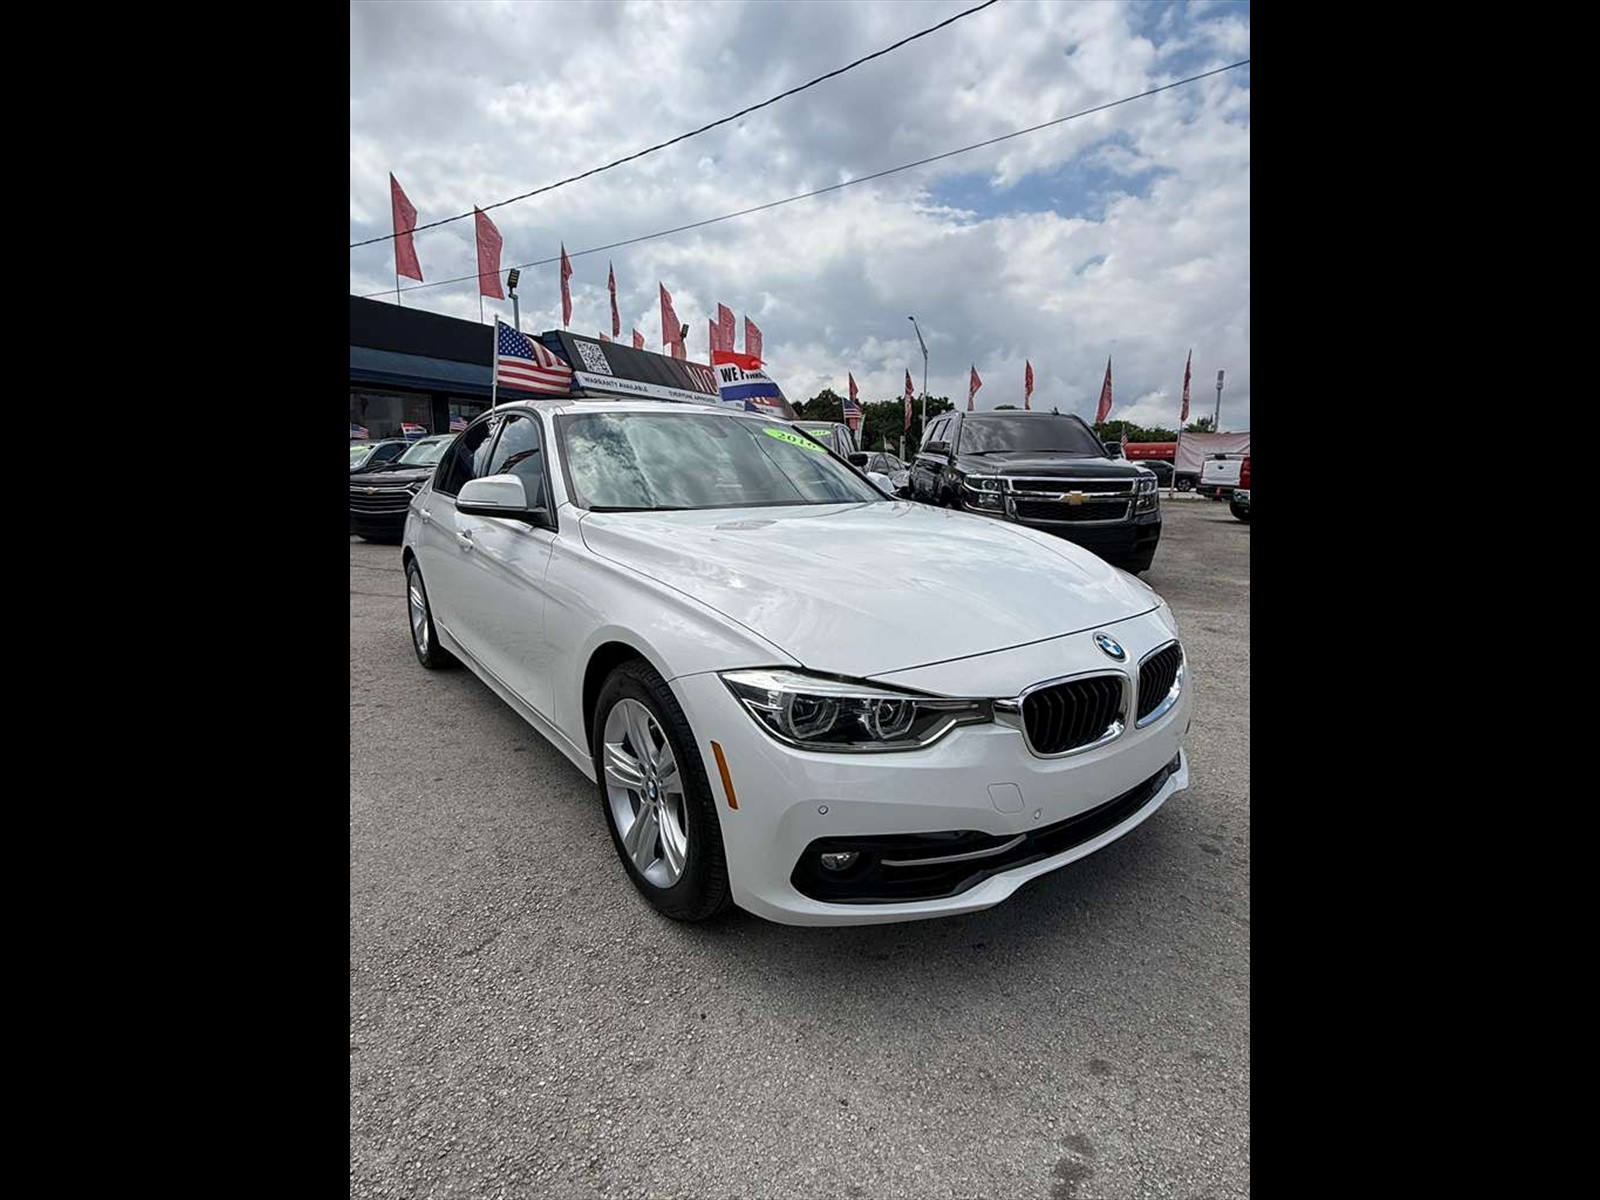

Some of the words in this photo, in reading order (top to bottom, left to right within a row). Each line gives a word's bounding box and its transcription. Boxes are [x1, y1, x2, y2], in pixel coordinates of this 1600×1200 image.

[720, 366, 739, 383] WE
[583, 376, 618, 388] WARRANTY
[619, 382, 649, 393] AVAILABLE
